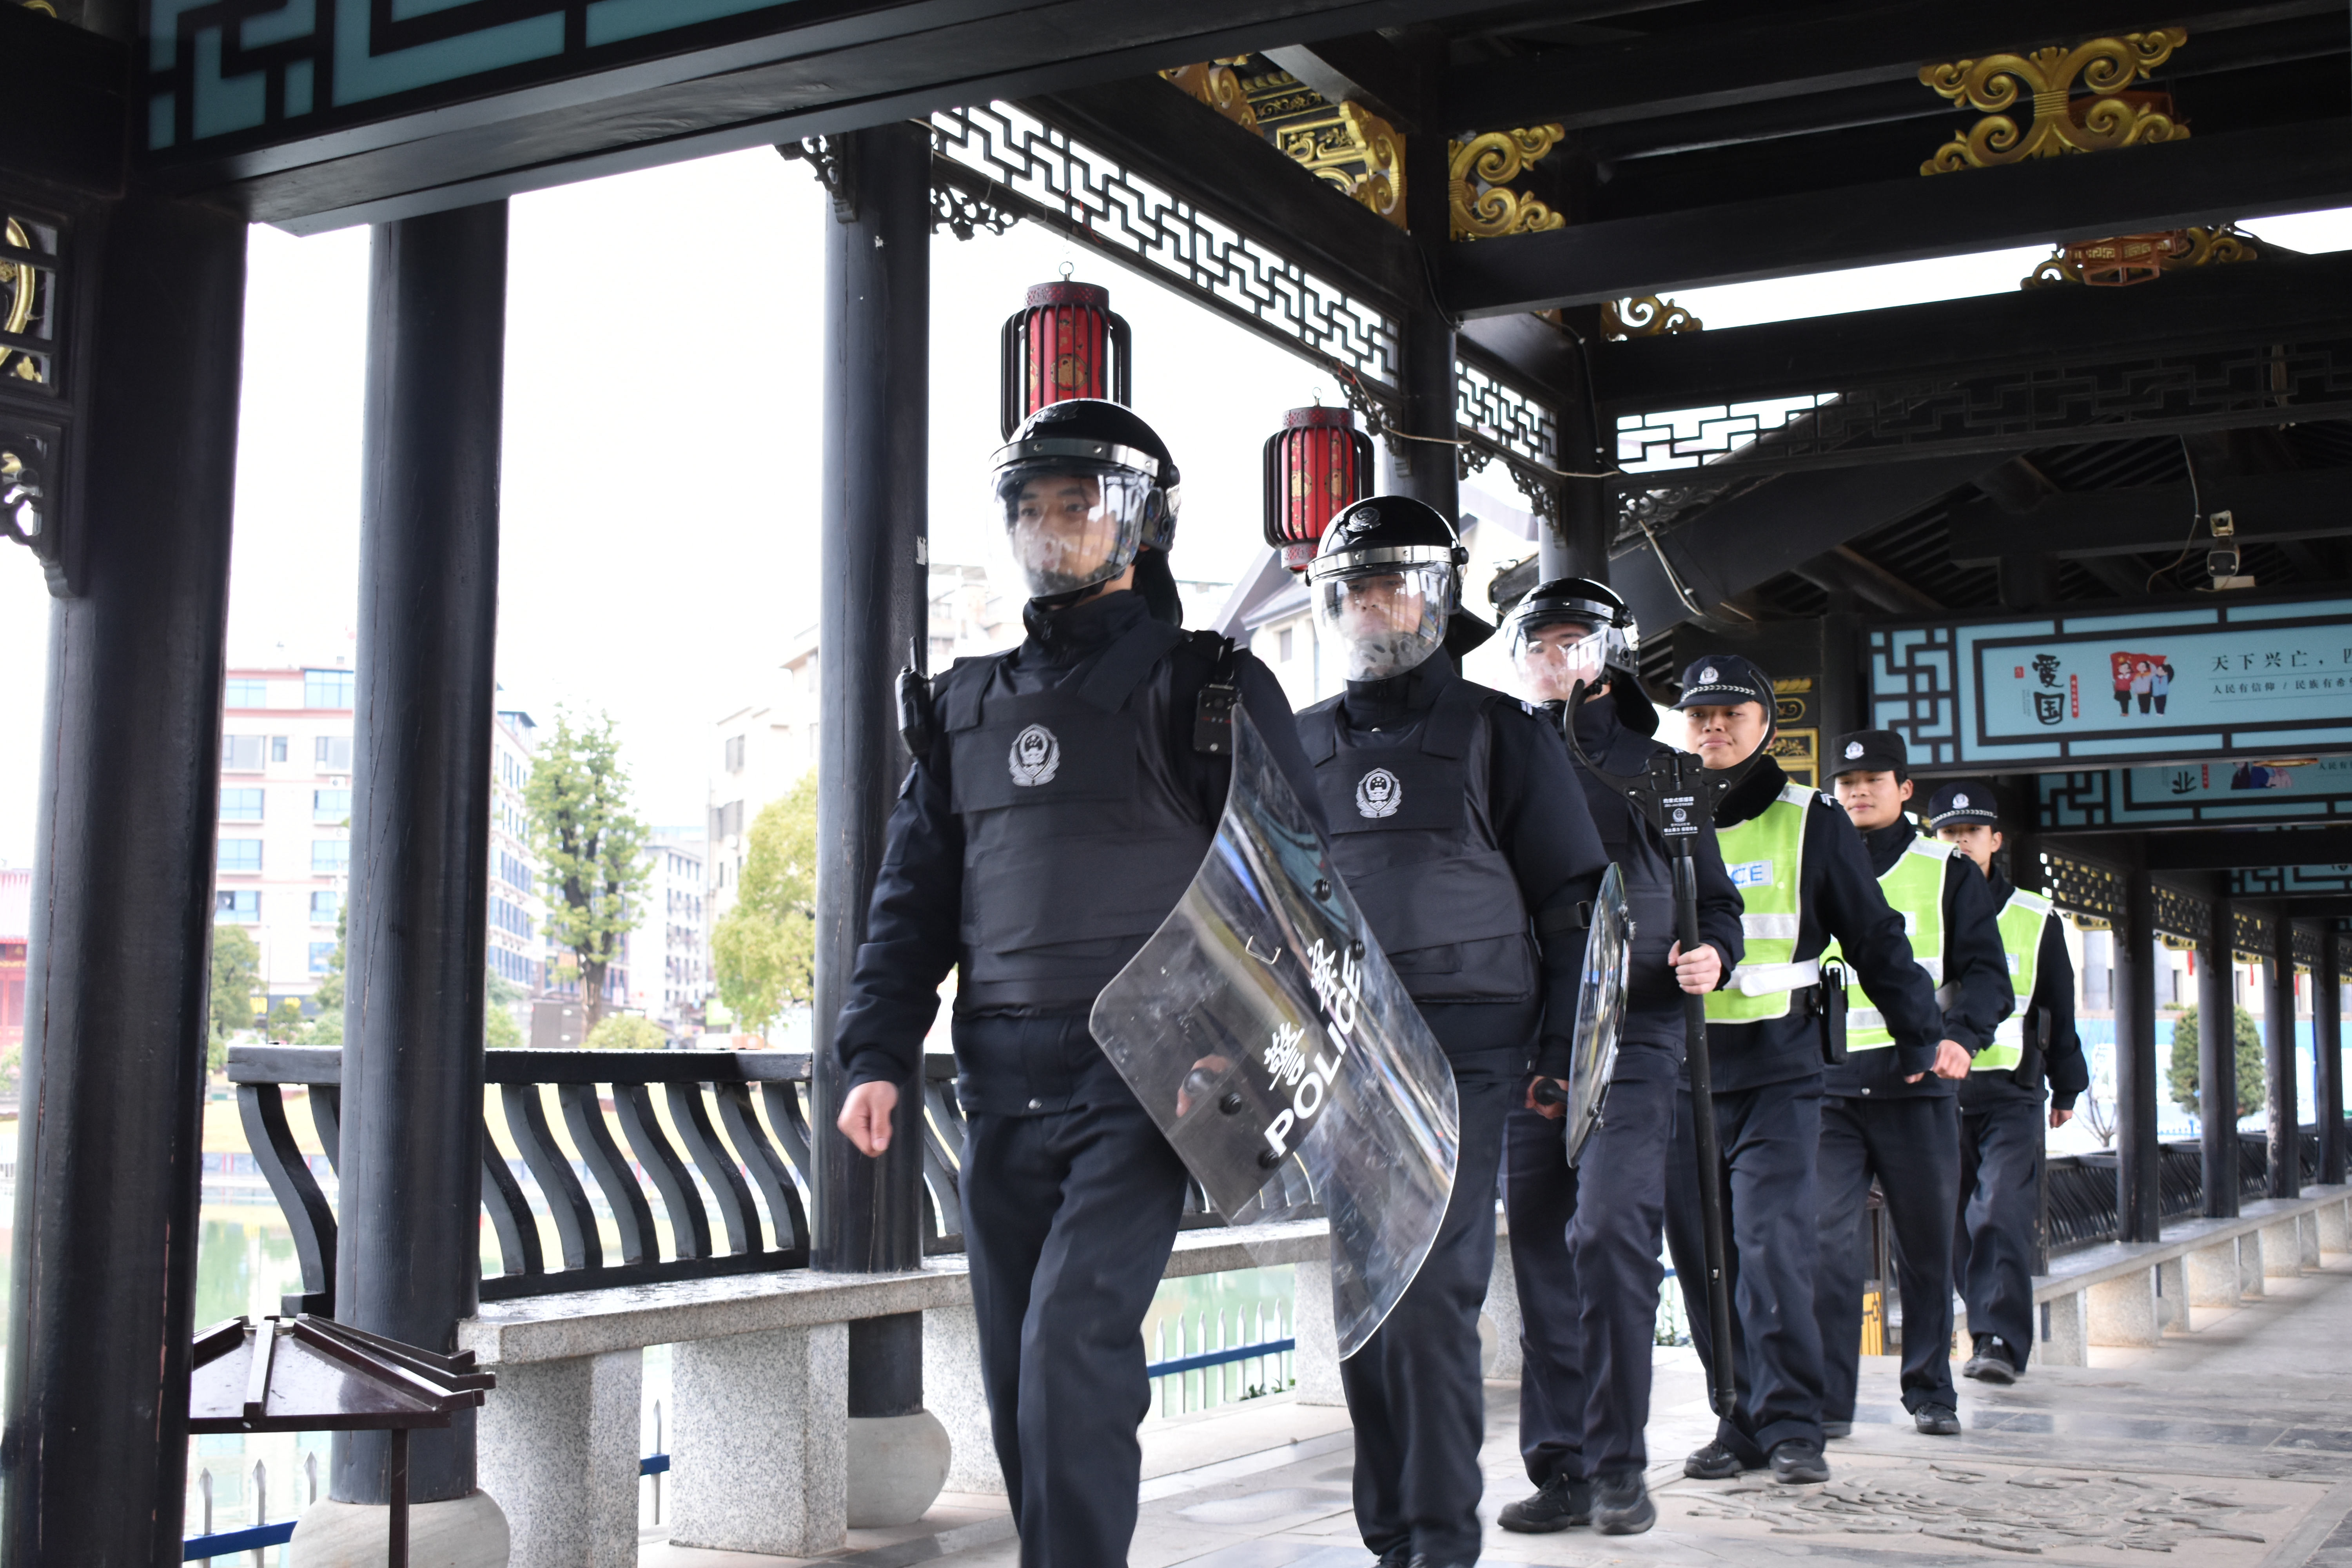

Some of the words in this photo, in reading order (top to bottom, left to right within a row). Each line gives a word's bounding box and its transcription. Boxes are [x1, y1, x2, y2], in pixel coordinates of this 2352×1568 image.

[2295, 677, 2352, 690] 民族有希
[2318, 761, 2352, 770] 人民有
[1264, 949, 1361, 1157] POLICE
